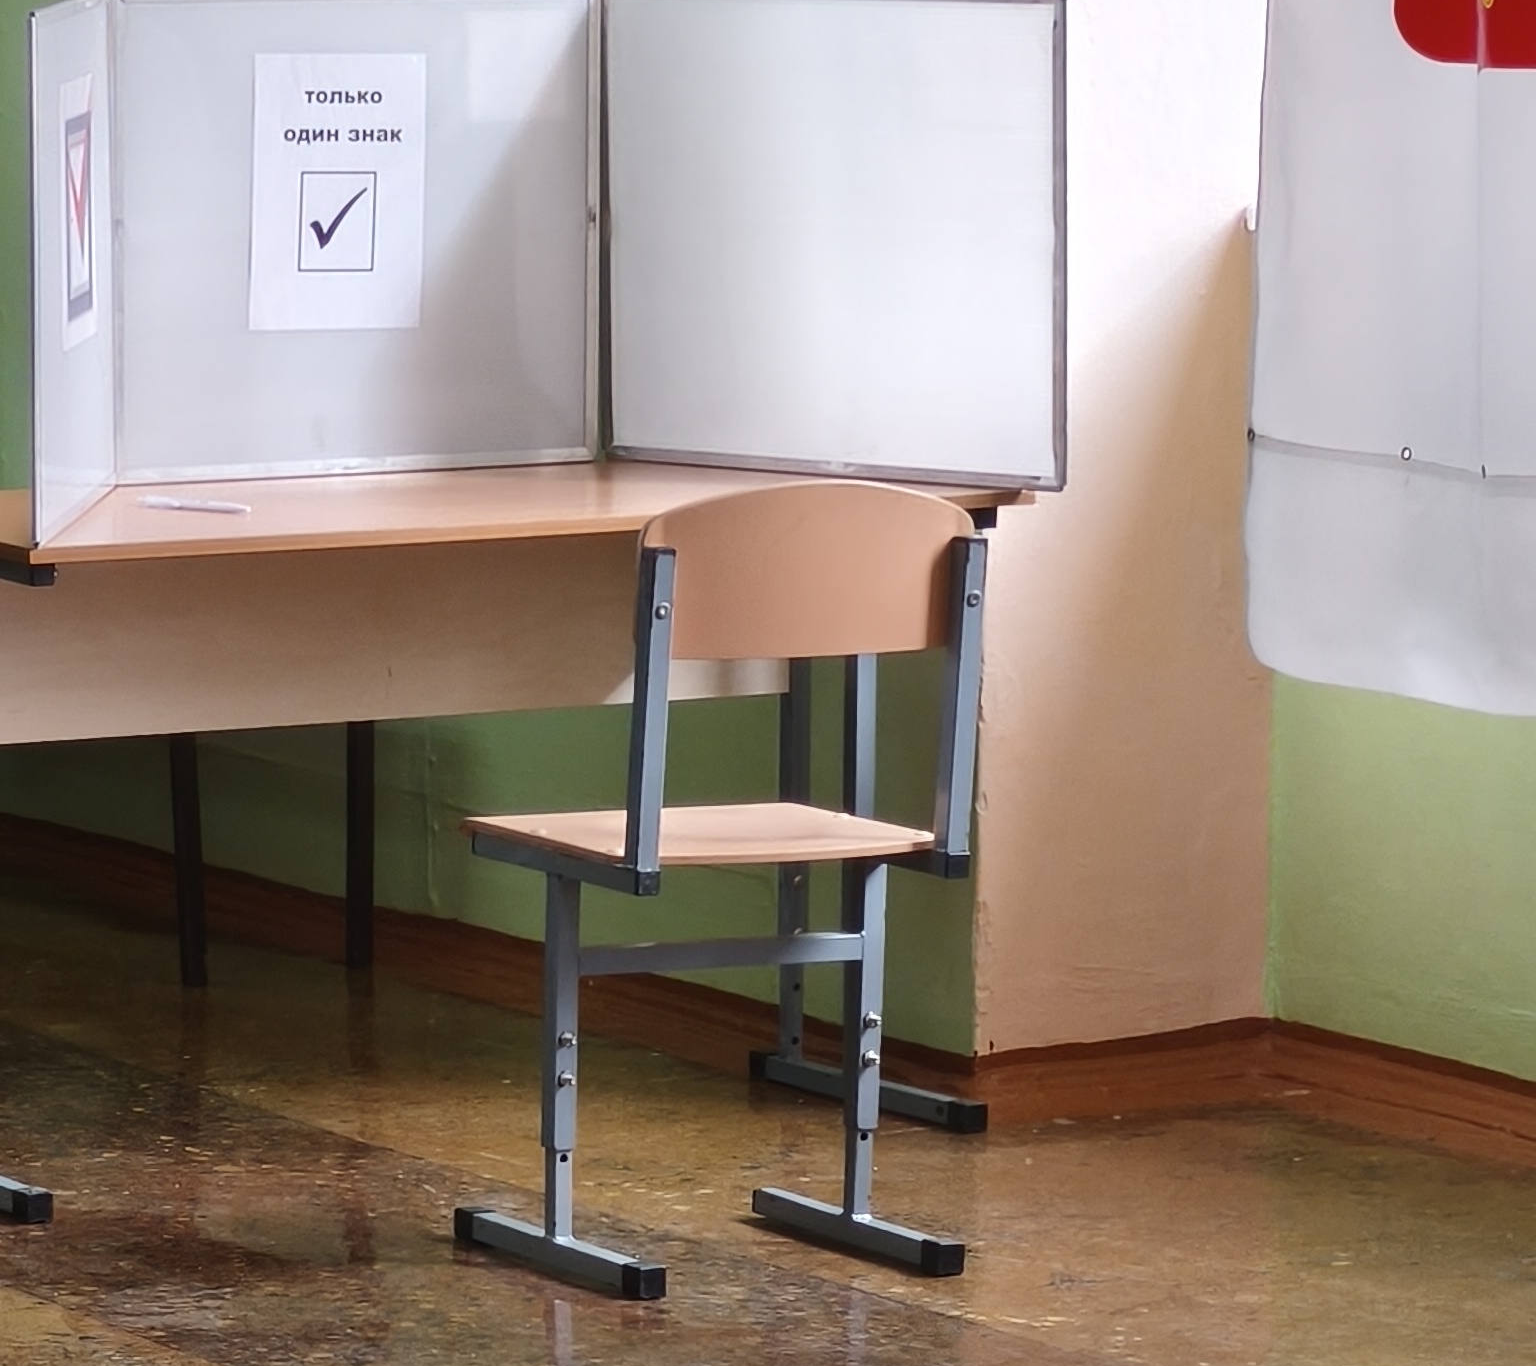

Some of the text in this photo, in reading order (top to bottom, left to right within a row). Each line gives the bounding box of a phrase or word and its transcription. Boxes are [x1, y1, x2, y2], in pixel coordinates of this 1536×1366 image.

[304, 90, 383, 104] только
[283, 128, 403, 145] один знак
